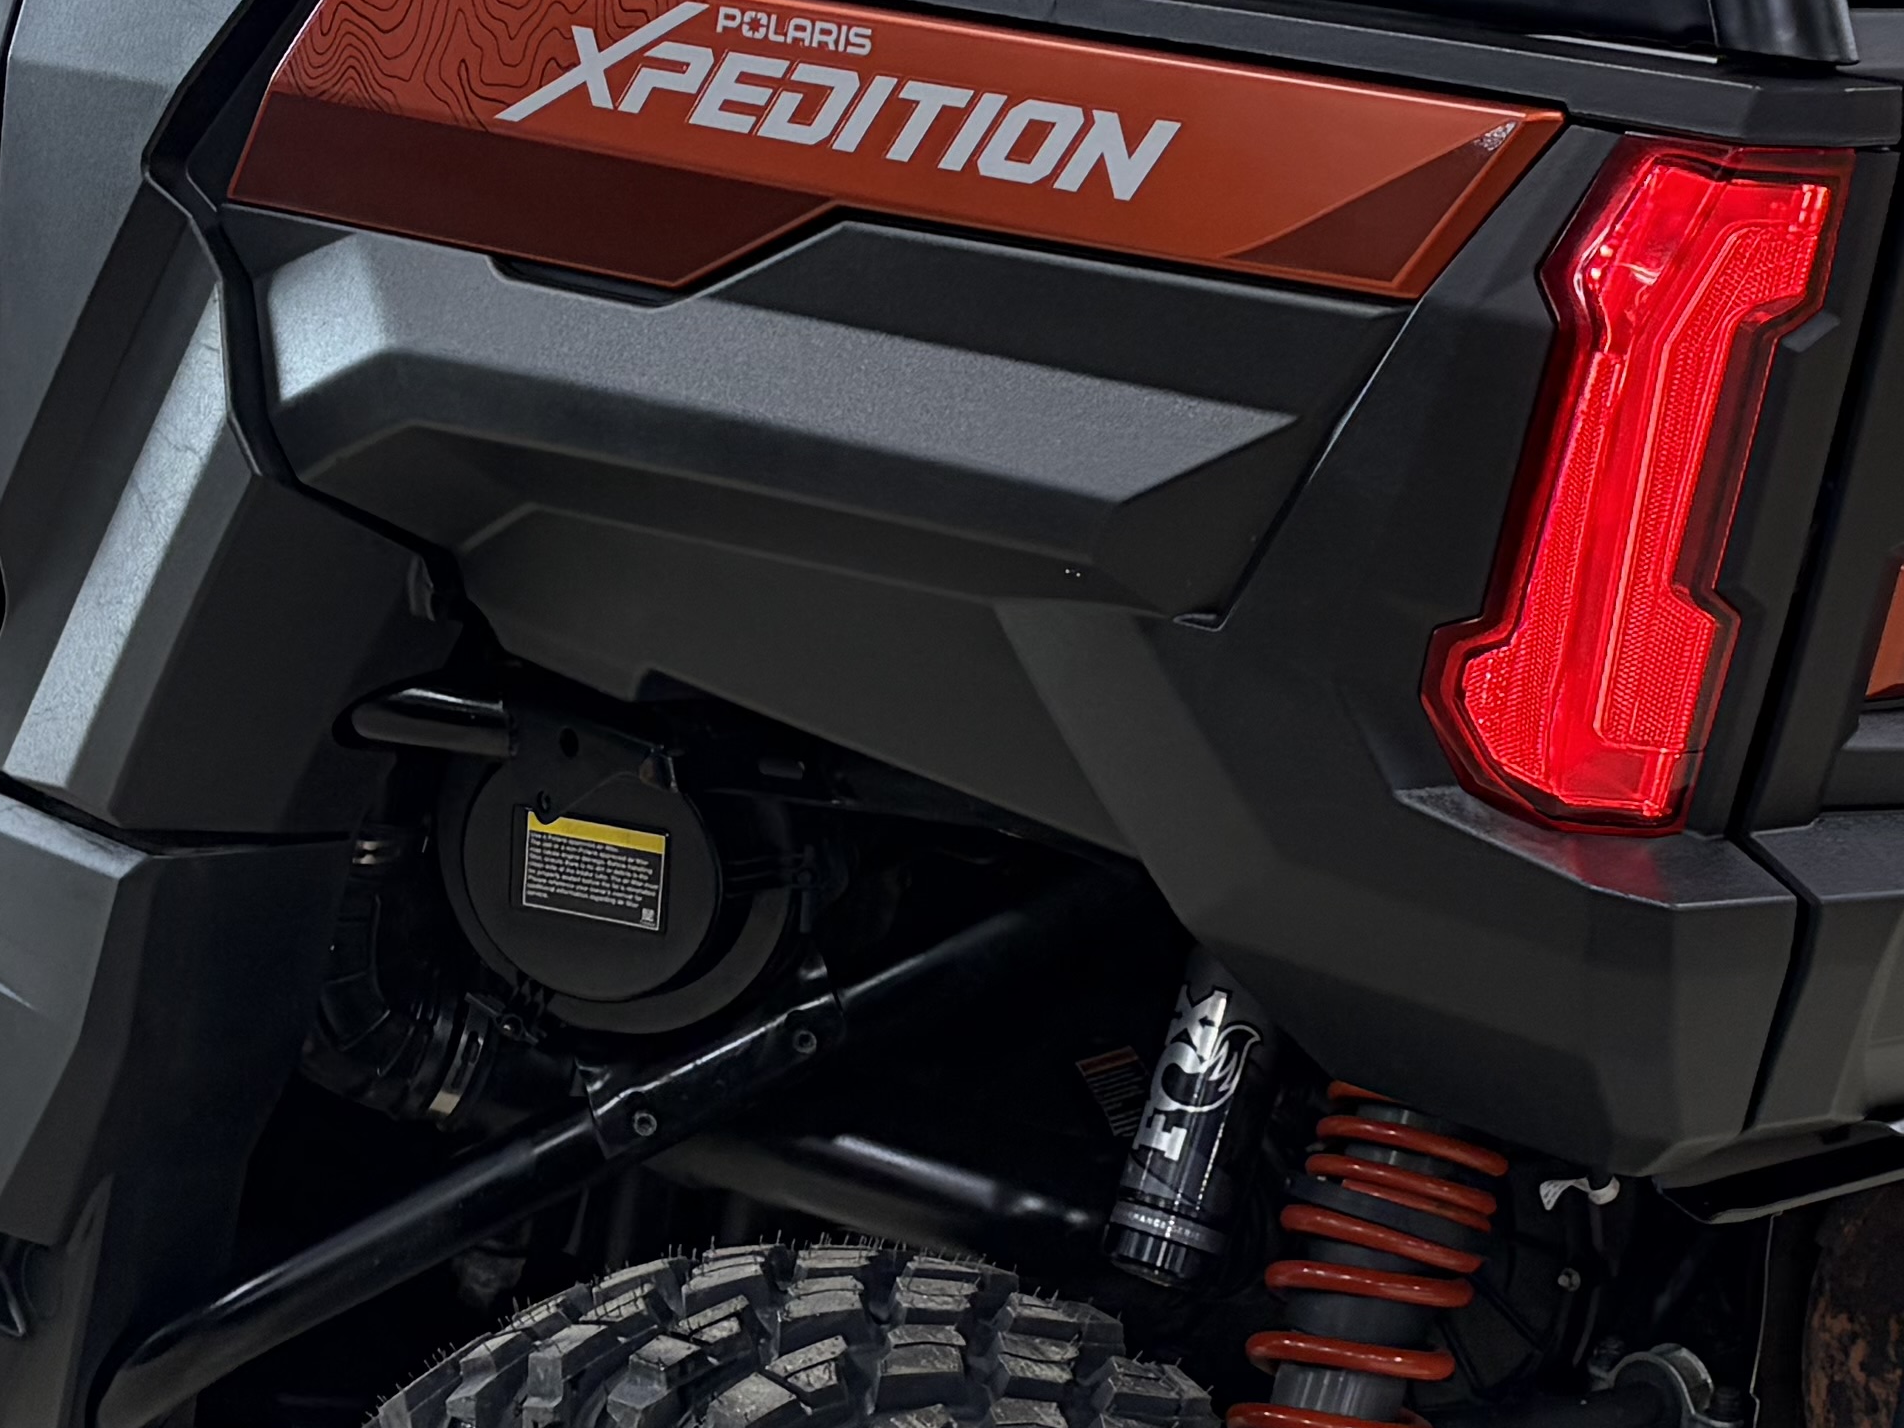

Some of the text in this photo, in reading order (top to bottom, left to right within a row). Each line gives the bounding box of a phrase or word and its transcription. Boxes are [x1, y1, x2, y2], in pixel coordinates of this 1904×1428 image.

[494, 1, 1182, 202] XPEDITION
[716, 6, 873, 55] POLARIS
[1131, 984, 1262, 1162] FOX
